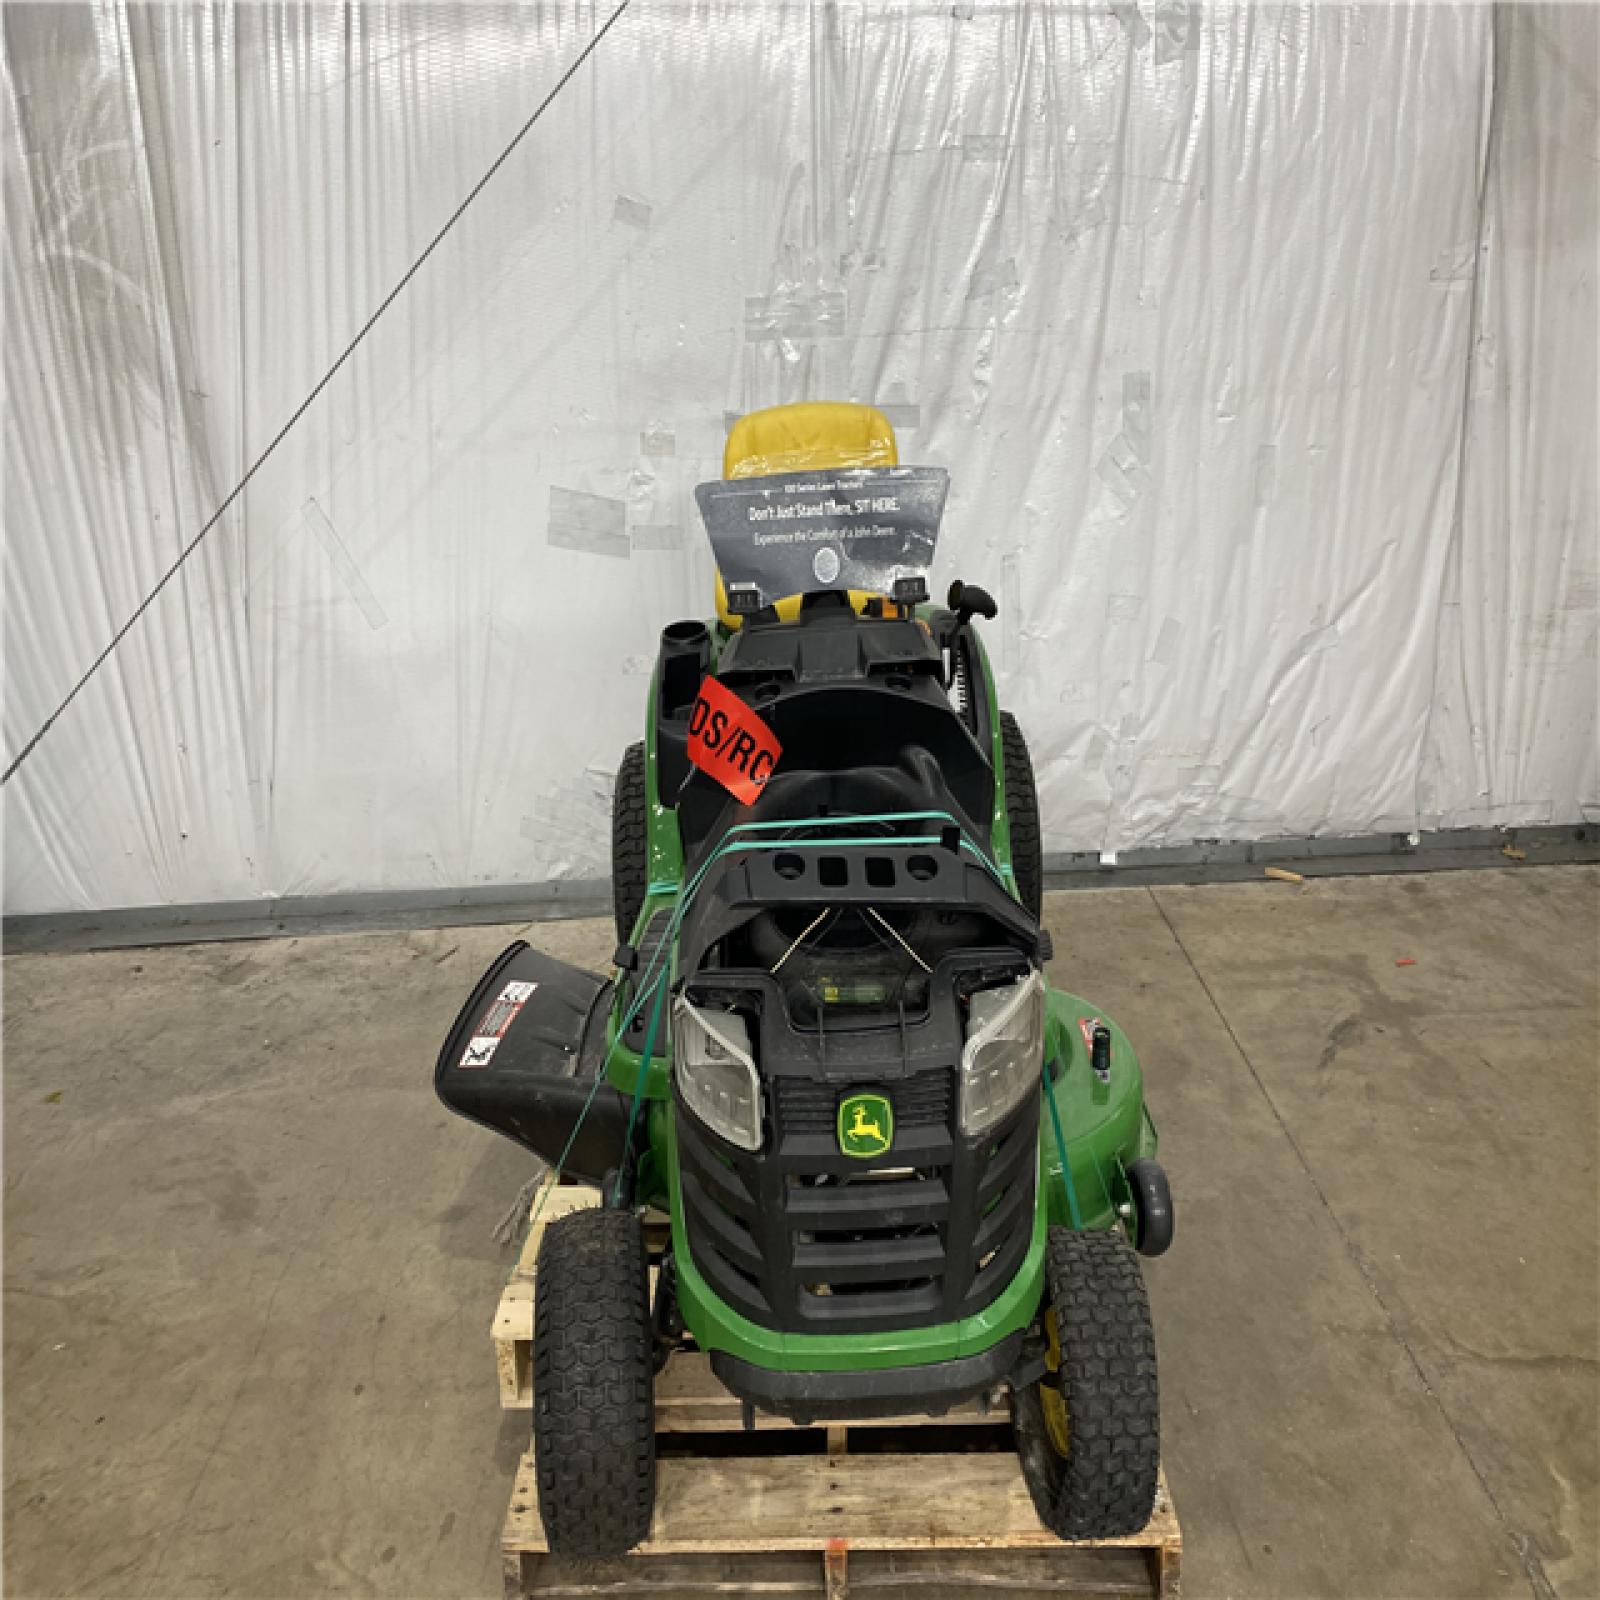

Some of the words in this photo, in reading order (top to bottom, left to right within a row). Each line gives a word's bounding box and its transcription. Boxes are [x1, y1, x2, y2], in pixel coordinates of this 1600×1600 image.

[749, 504, 775, 520] Don't
[776, 503, 795, 518] Just
[795, 502, 823, 518] Stand
[795, 529, 806, 543] the
[839, 527, 847, 539] of
[854, 526, 871, 538] John
